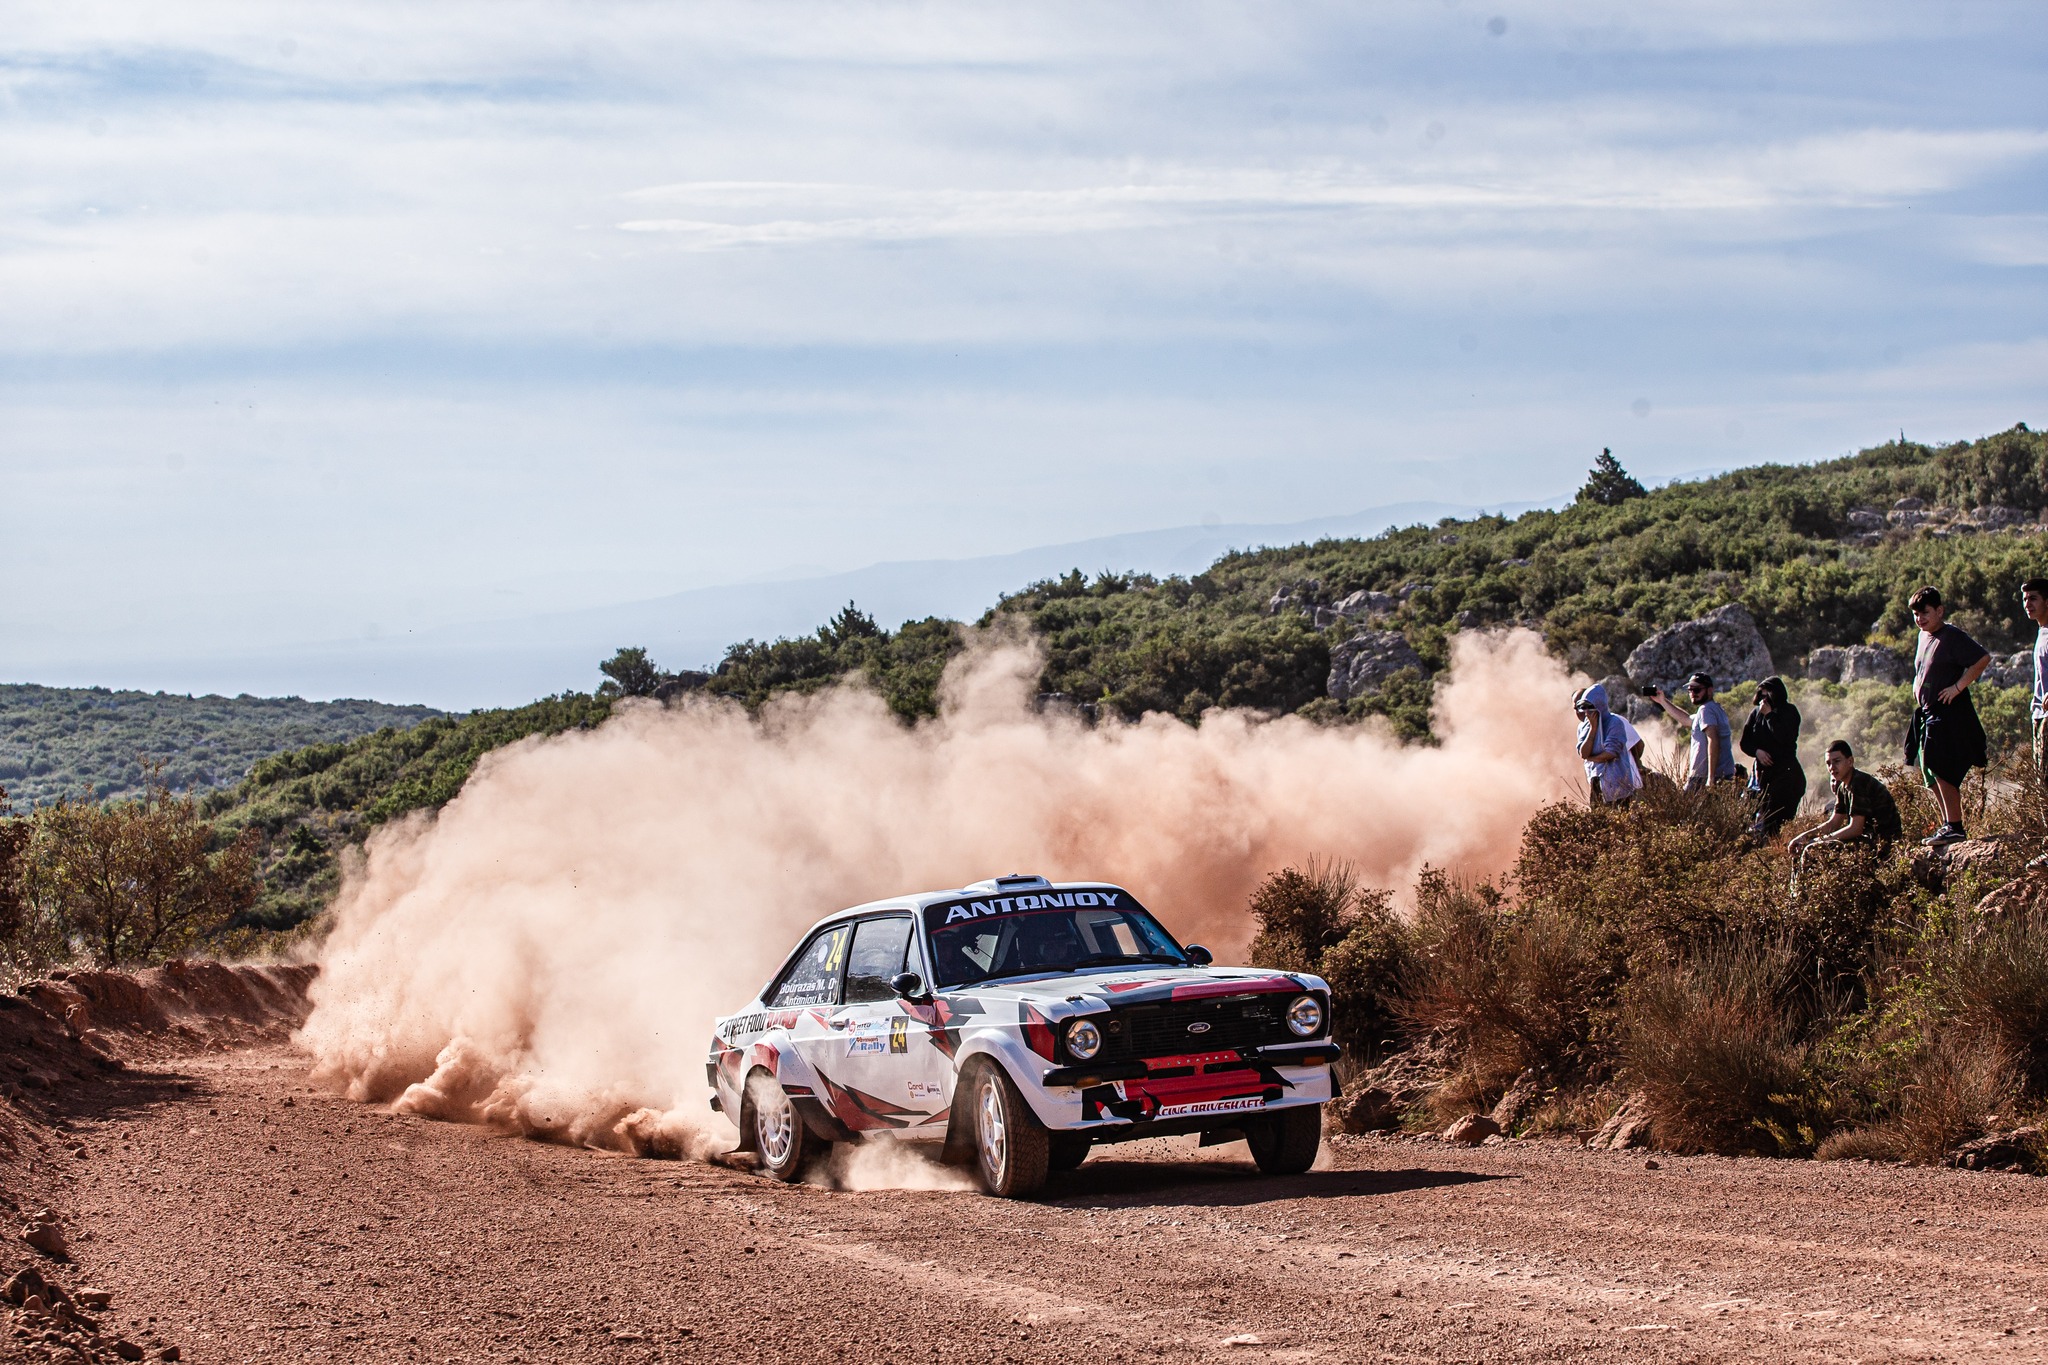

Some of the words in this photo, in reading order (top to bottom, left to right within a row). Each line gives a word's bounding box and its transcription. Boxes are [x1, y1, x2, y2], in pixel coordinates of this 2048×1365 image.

[945, 892, 1119, 924] ΑΝΤΩΝΙΟΥ
[826, 931, 847, 972] 24
[779, 982, 816, 995] Bourazas
[723, 1016, 749, 1038] STREET
[746, 1012, 768, 1033] FOOD
[893, 1022, 906, 1048] 24
[861, 1042, 885, 1052] Rally
[1147, 1106, 1188, 1118] ACING
[1191, 1098, 1266, 1113] DRIVESHAFTS
